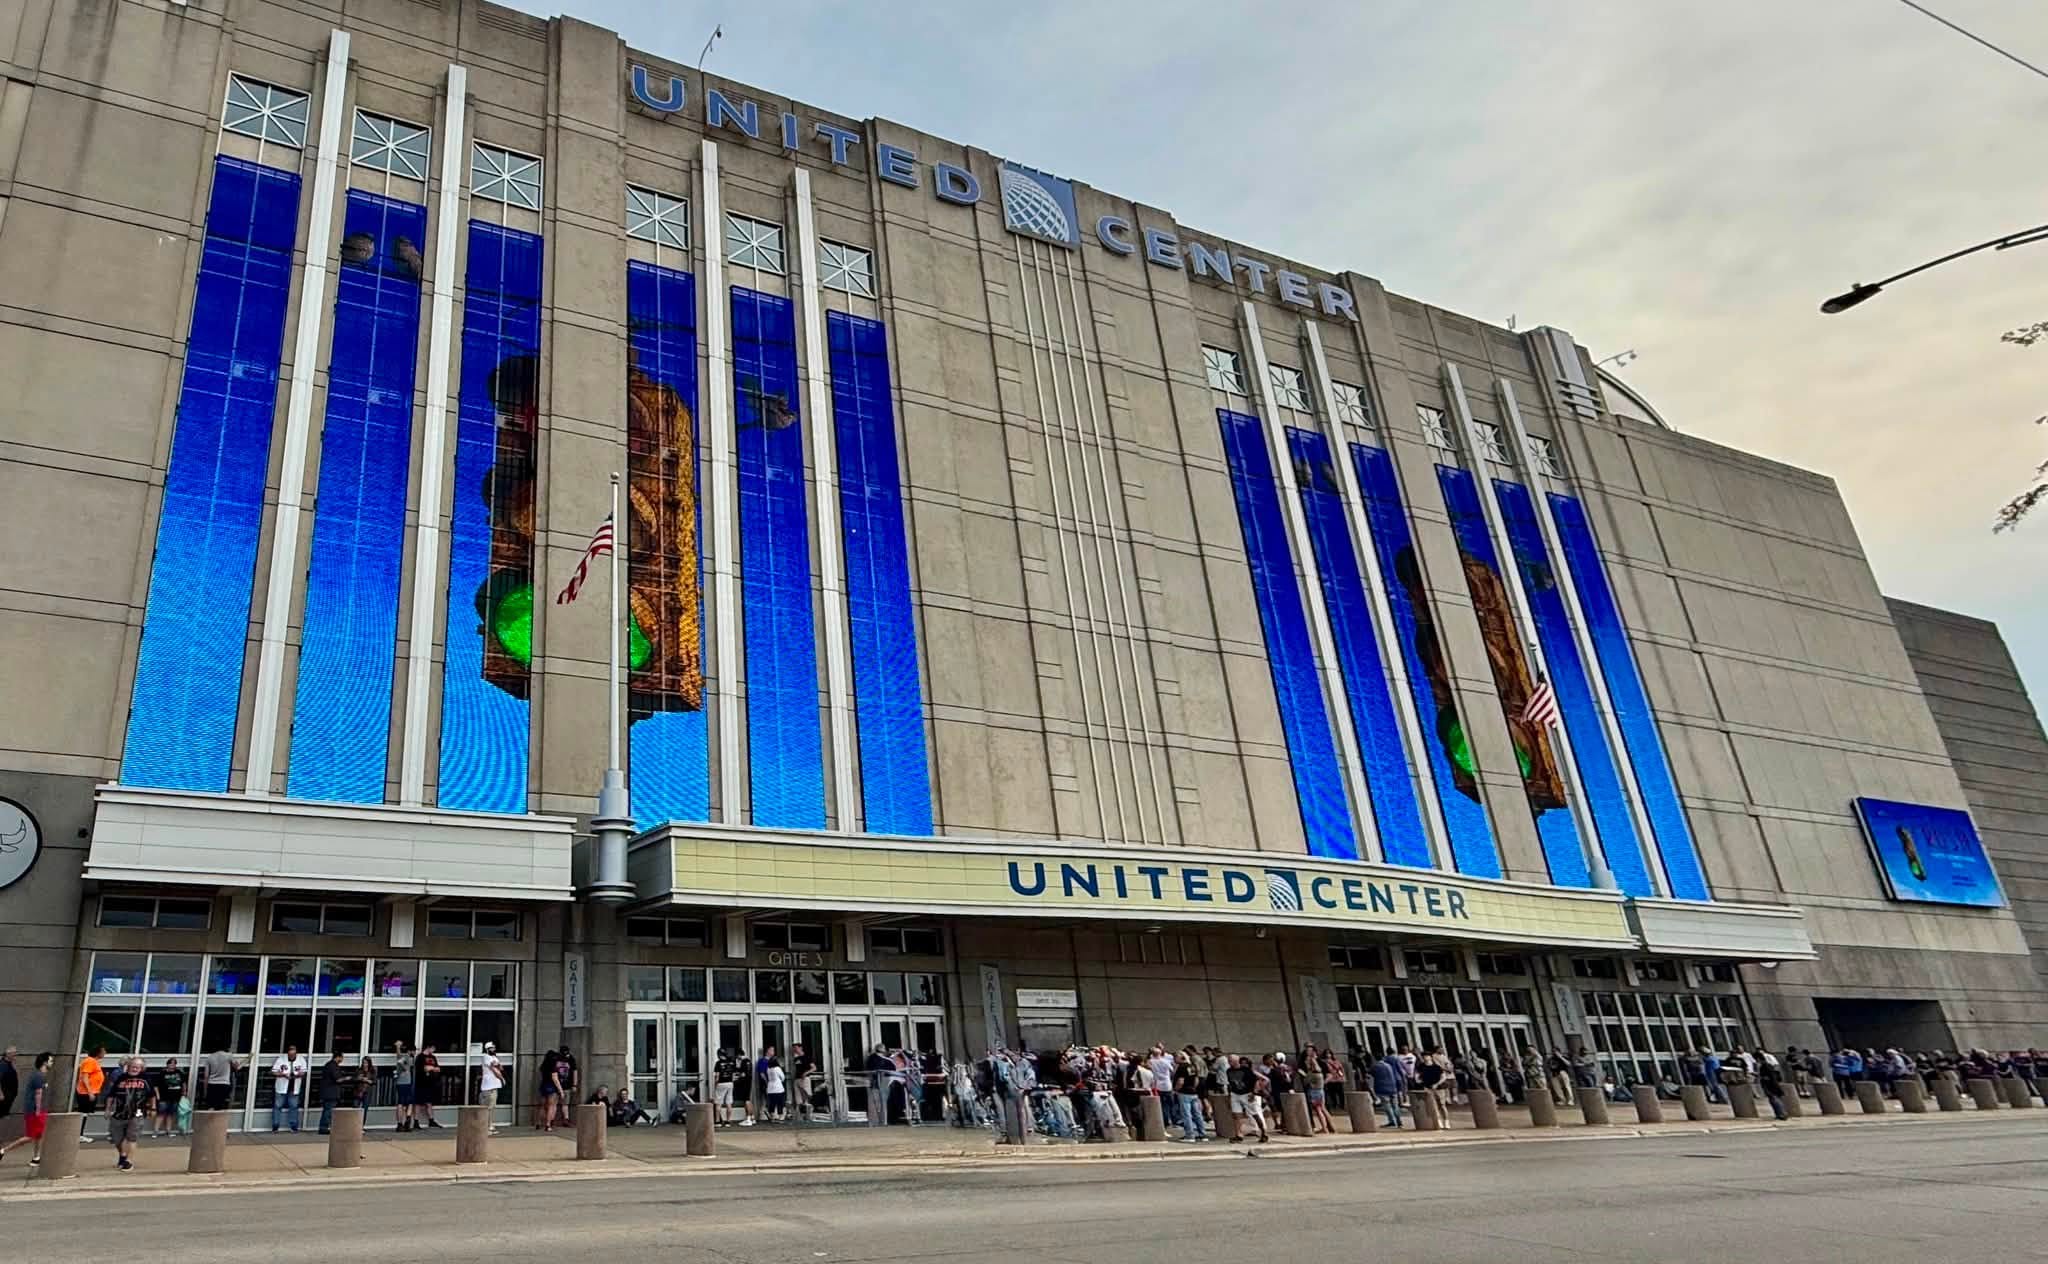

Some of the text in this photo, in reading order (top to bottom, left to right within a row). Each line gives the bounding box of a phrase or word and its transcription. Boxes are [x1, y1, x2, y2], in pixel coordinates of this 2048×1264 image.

[630, 64, 1360, 323] UNITED CENTER
[1007, 861, 1470, 920] UNITED CENTER
[768, 951, 824, 967] GATE 3
[568, 959, 578, 1022] GATE 3
